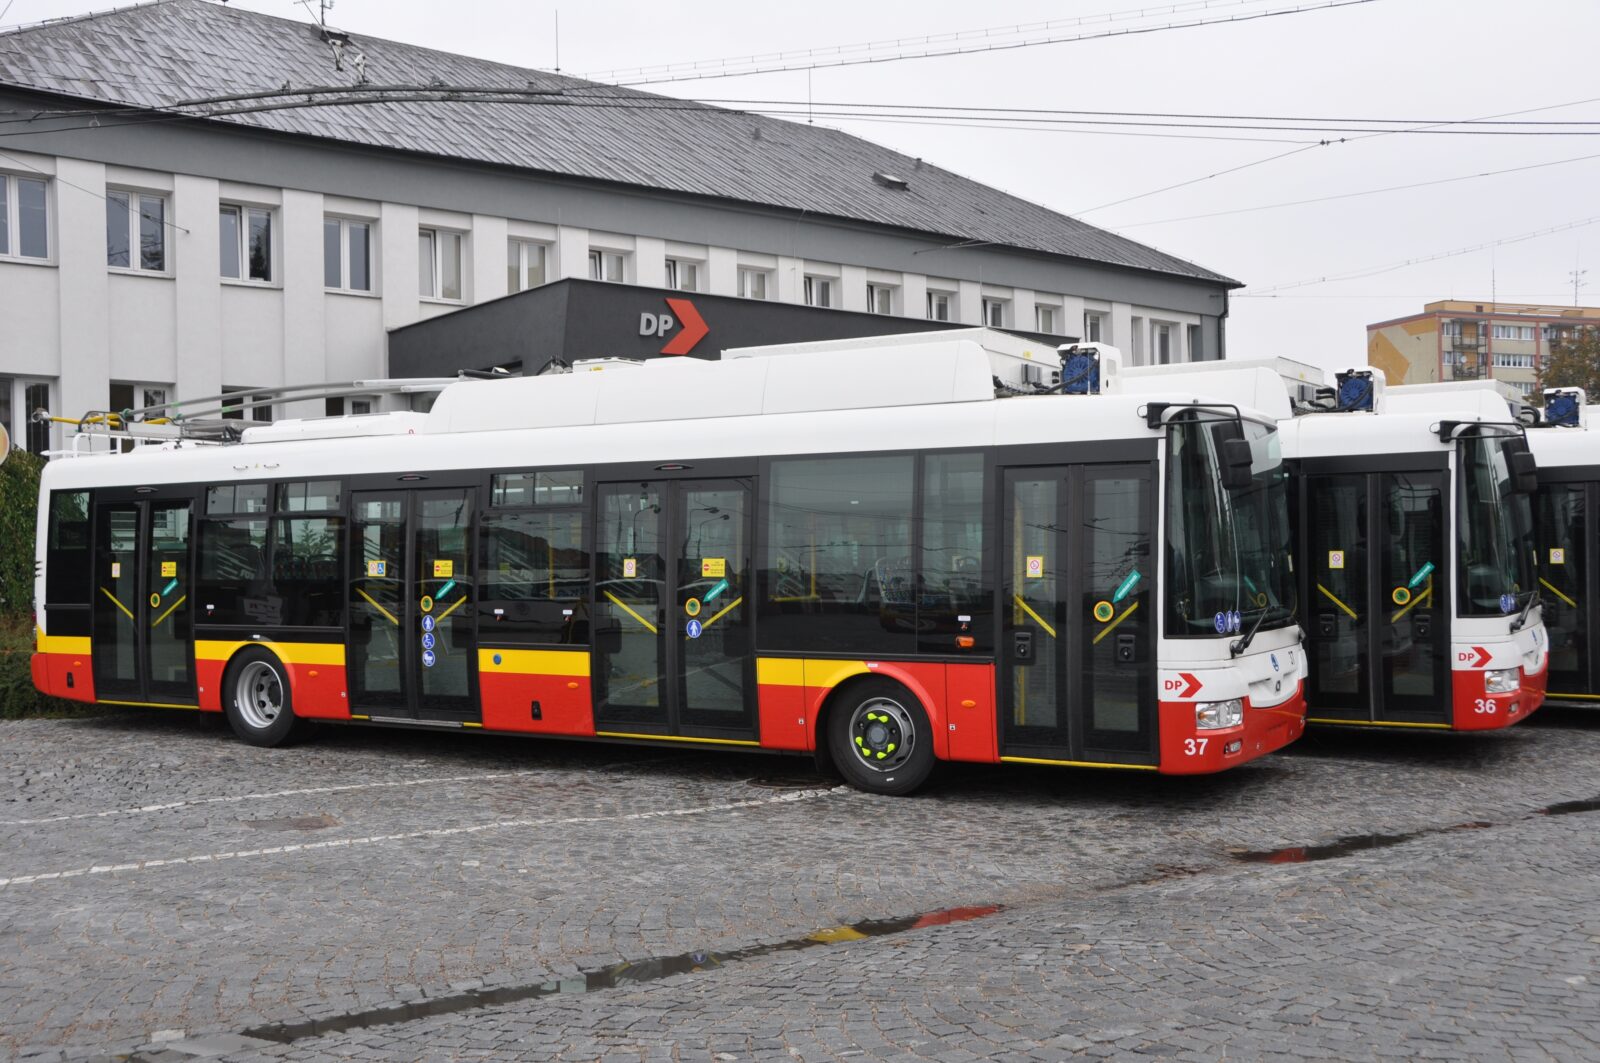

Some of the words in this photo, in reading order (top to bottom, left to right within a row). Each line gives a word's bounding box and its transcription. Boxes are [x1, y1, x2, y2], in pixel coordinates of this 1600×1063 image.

[639, 312, 674, 337] DP
[1458, 652, 1475, 661] DP
[1164, 680, 1183, 691] DP
[1474, 698, 1496, 714] 36
[1184, 737, 1209, 756] 37
